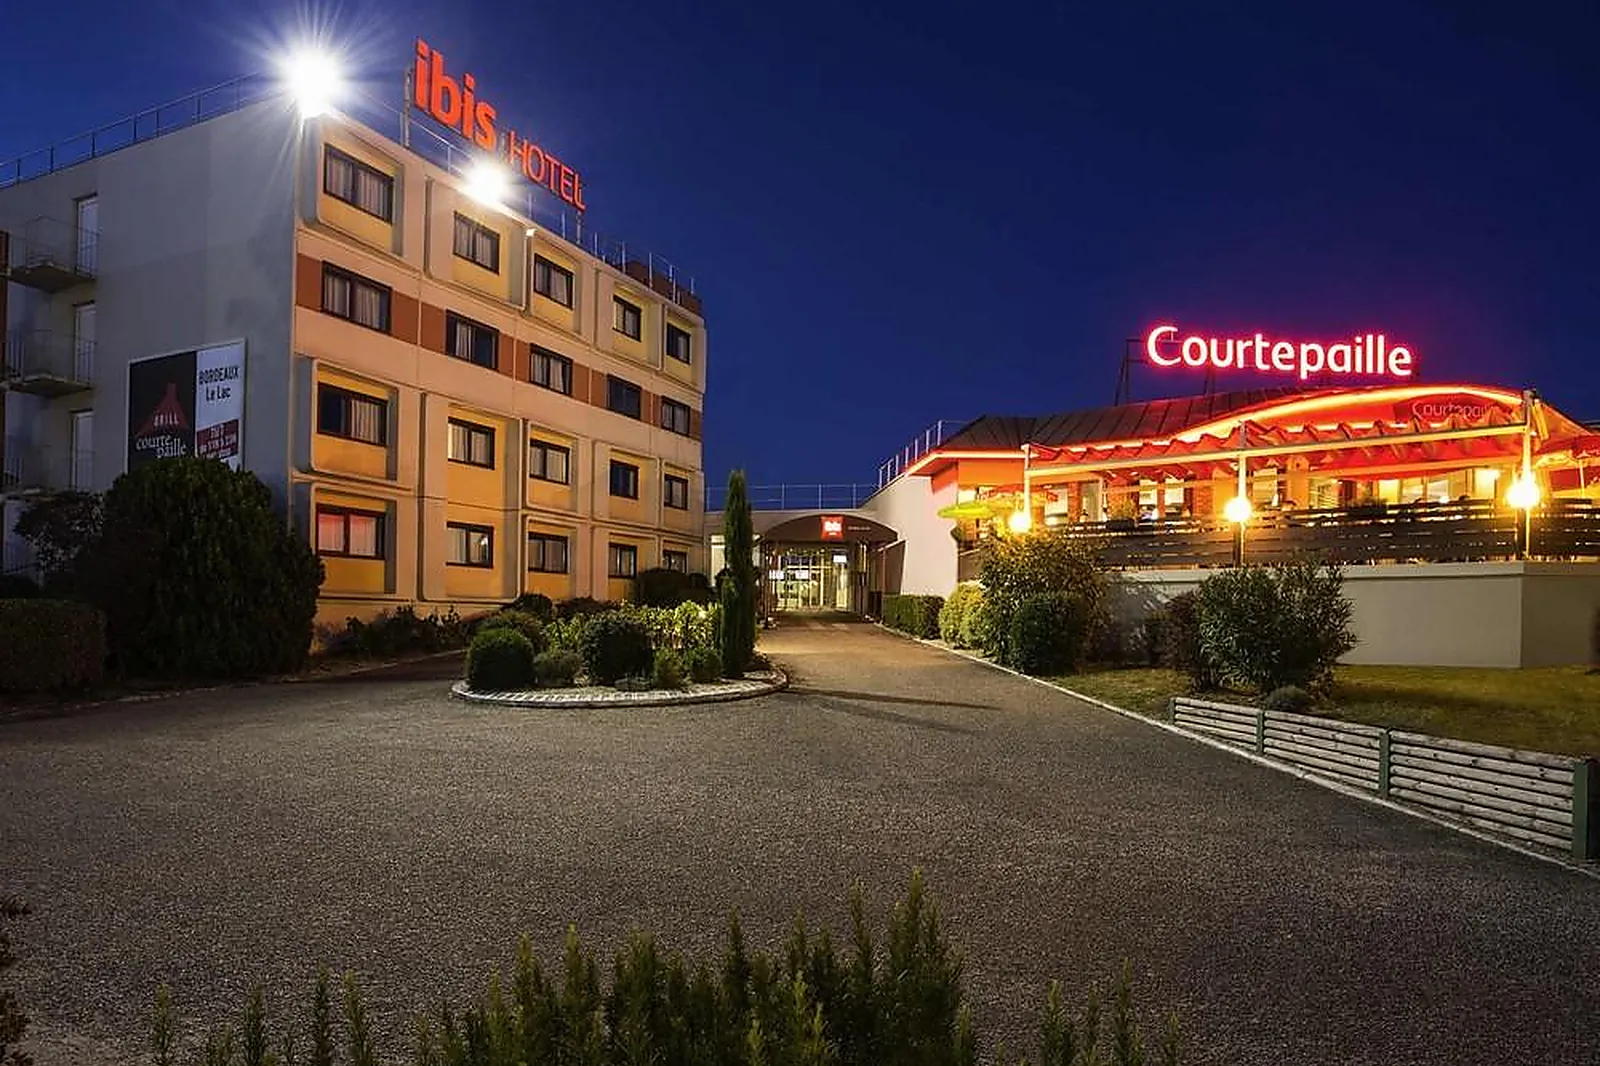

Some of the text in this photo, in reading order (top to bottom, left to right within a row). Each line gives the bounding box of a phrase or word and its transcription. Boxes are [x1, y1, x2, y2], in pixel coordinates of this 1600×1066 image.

[413, 38, 586, 212] ibis HOTEL
[1147, 325, 1412, 380] Courtepaille
[199, 366, 239, 385] BORDEAUX
[205, 385, 231, 402] Le Lac
